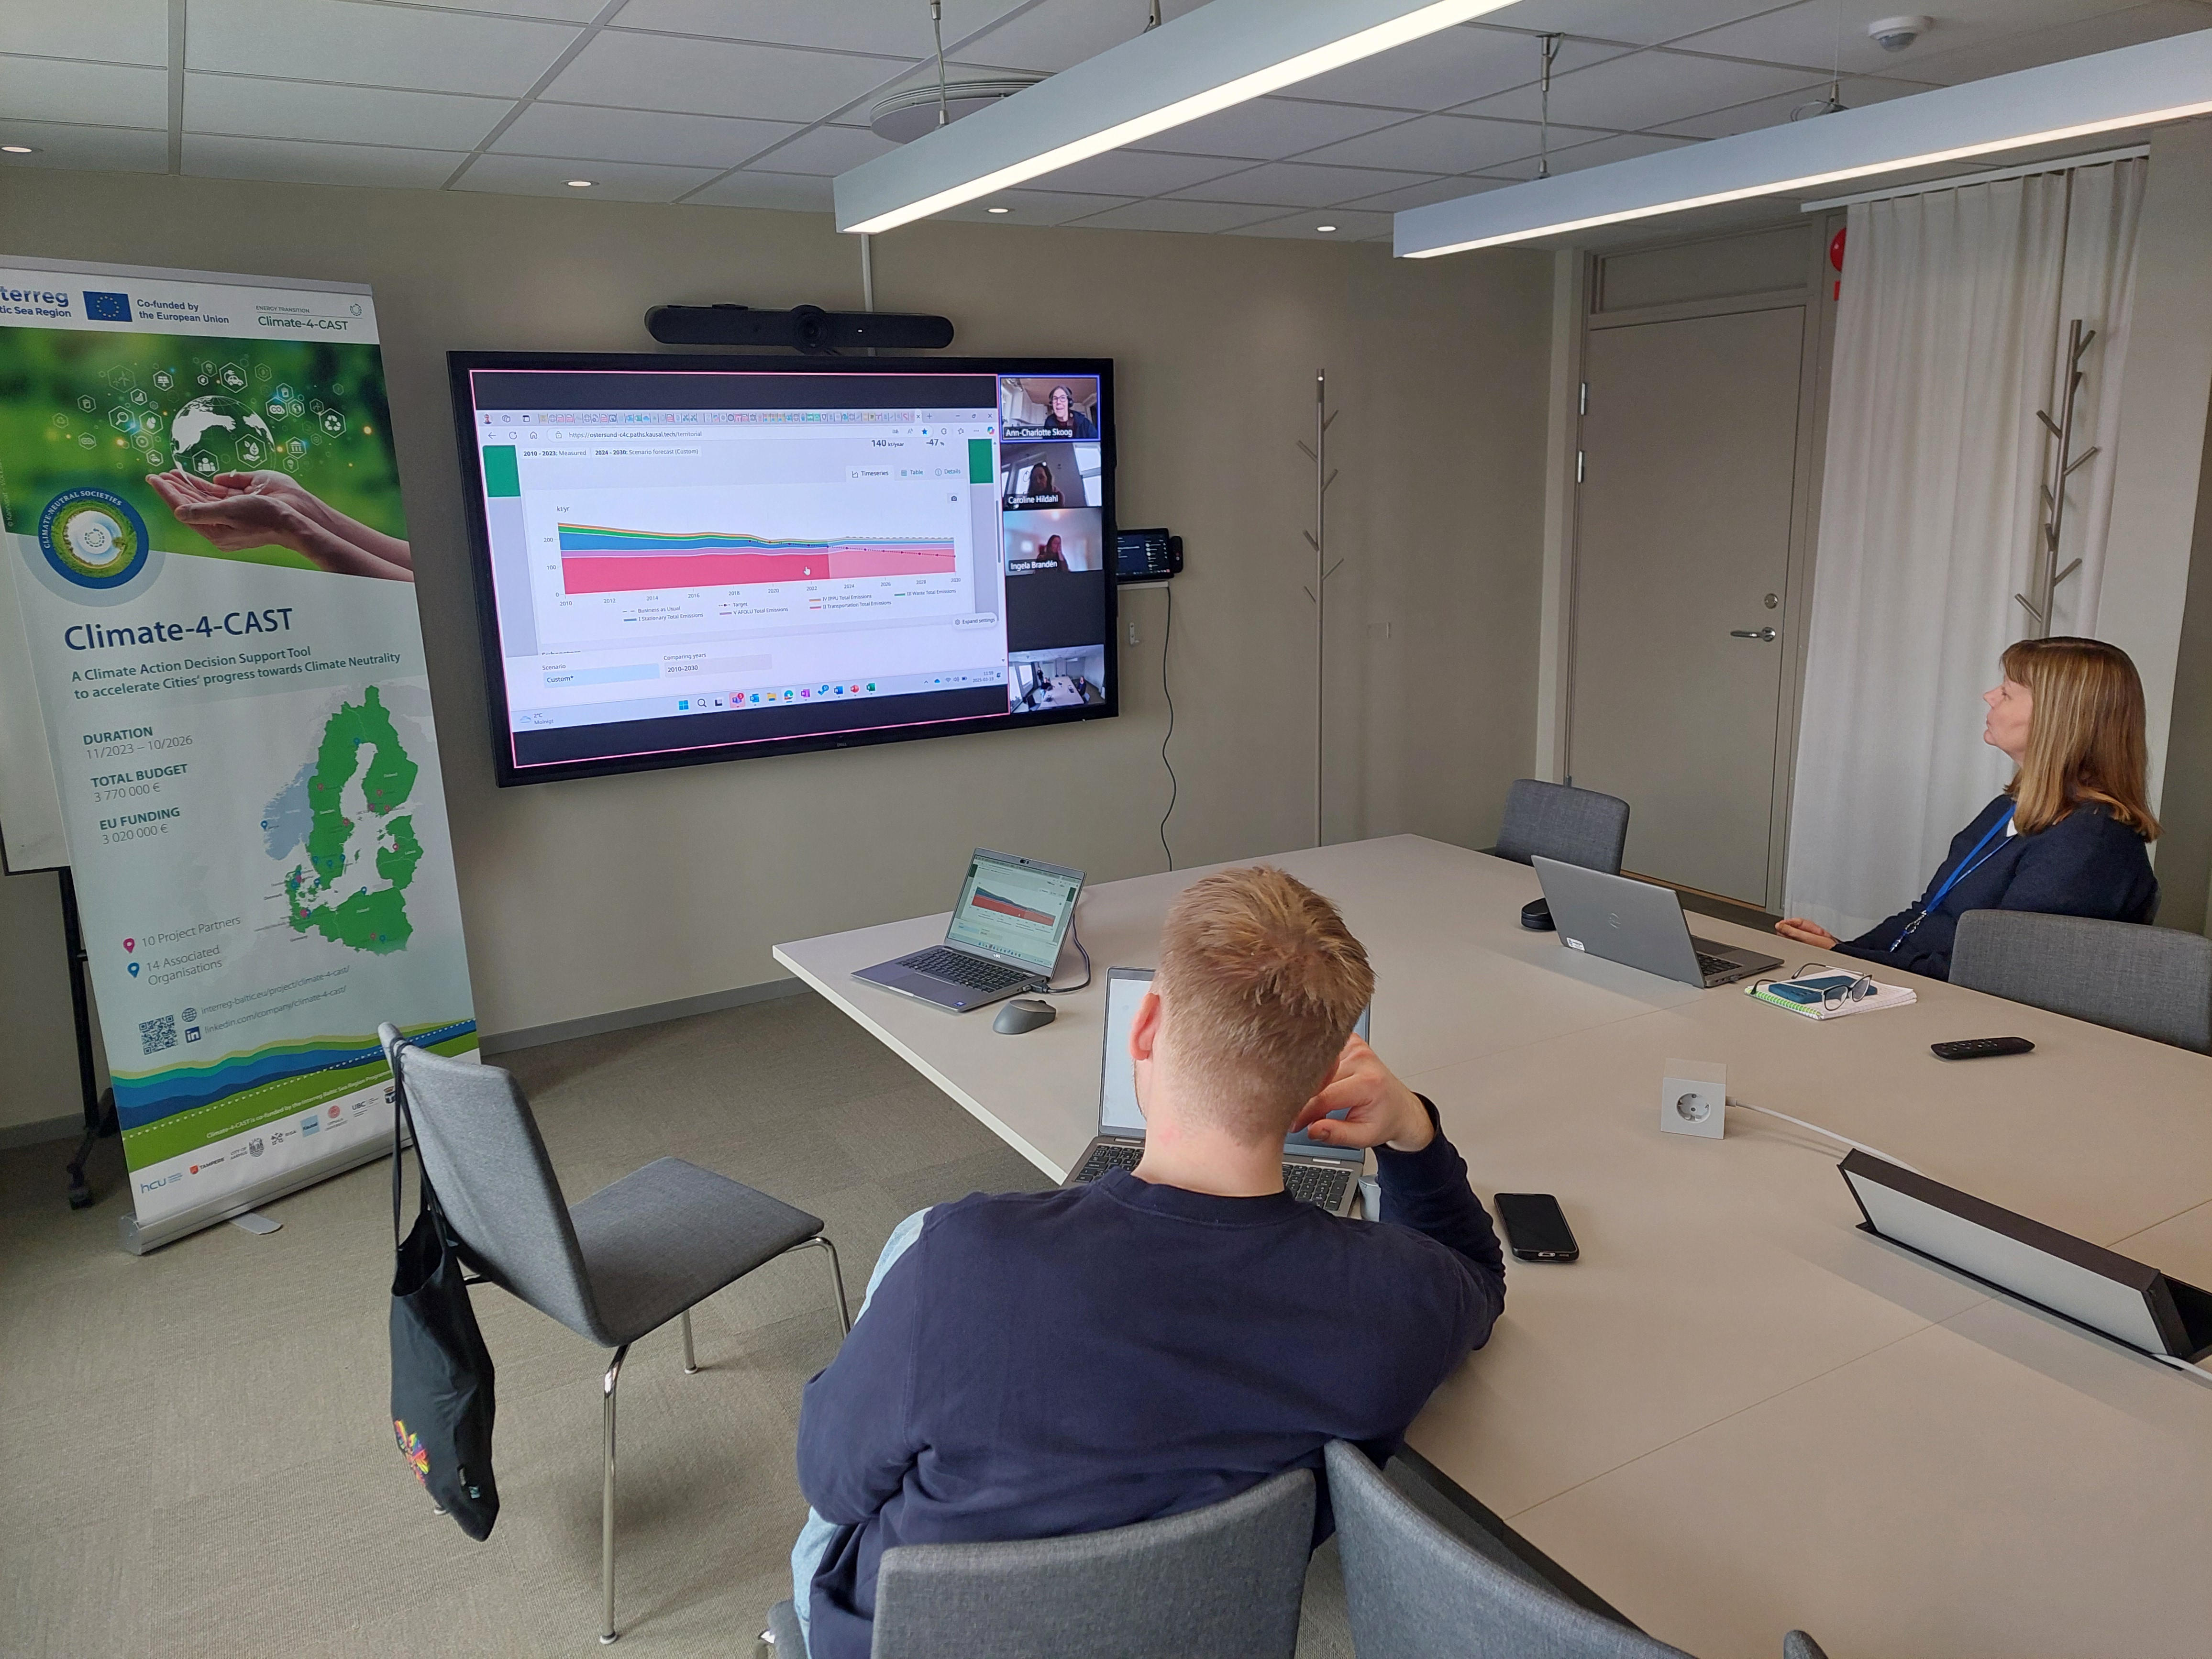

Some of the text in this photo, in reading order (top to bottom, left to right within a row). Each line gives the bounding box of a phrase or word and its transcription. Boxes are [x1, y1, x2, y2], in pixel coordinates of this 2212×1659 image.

[14, 306, 34, 315] Sea
[35, 308, 72, 318] Region
[137, 299, 199, 312] Co-funded by
[139, 311, 230, 323] the European Union
[258, 316, 348, 331] Climate-4-CAST
[1006, 428, 1073, 438] Ann-Charlotte Skoog
[42, 490, 122, 549] CLIMATE-NEUTRAL SOCIETIES
[1011, 560, 1058, 571] Ingela Brandén
[65, 608, 293, 651] Climate-4-CAST
[72, 646, 311, 682] A Climate Action Decision Support Tool
[74, 689, 89, 700] to
[92, 681, 160, 697] accelerate
[203, 670, 255, 687] progress
[257, 663, 303, 678] towards
[305, 659, 347, 672] Climate
[348, 652, 400, 667] Neutrality
[83, 726, 153, 745] DURATION
[86, 743, 134, 759] 11/2023
[147, 735, 193, 750] 10/2026
[90, 763, 188, 788] TOTAL BUDGET
[94, 782, 162, 803] 3 770 000 €
[100, 807, 180, 830] EU FUNDING
[102, 823, 169, 845] 3 020 000 €
[142, 936, 155, 947] 10
[157, 927, 197, 942] Project
[198, 917, 241, 934] Partners
[146, 944, 220, 972] 14 Associated
[148, 960, 223, 985] Organisations
[205, 985, 347, 1034] linkedin.com/company/climate-4-cast/
[256, 1106, 284, 1121] co-funded
[352, 1101, 366, 1111] UBC
[199, 1157, 225, 1170] TAMPERE
[140, 1178, 166, 1194] hcu
